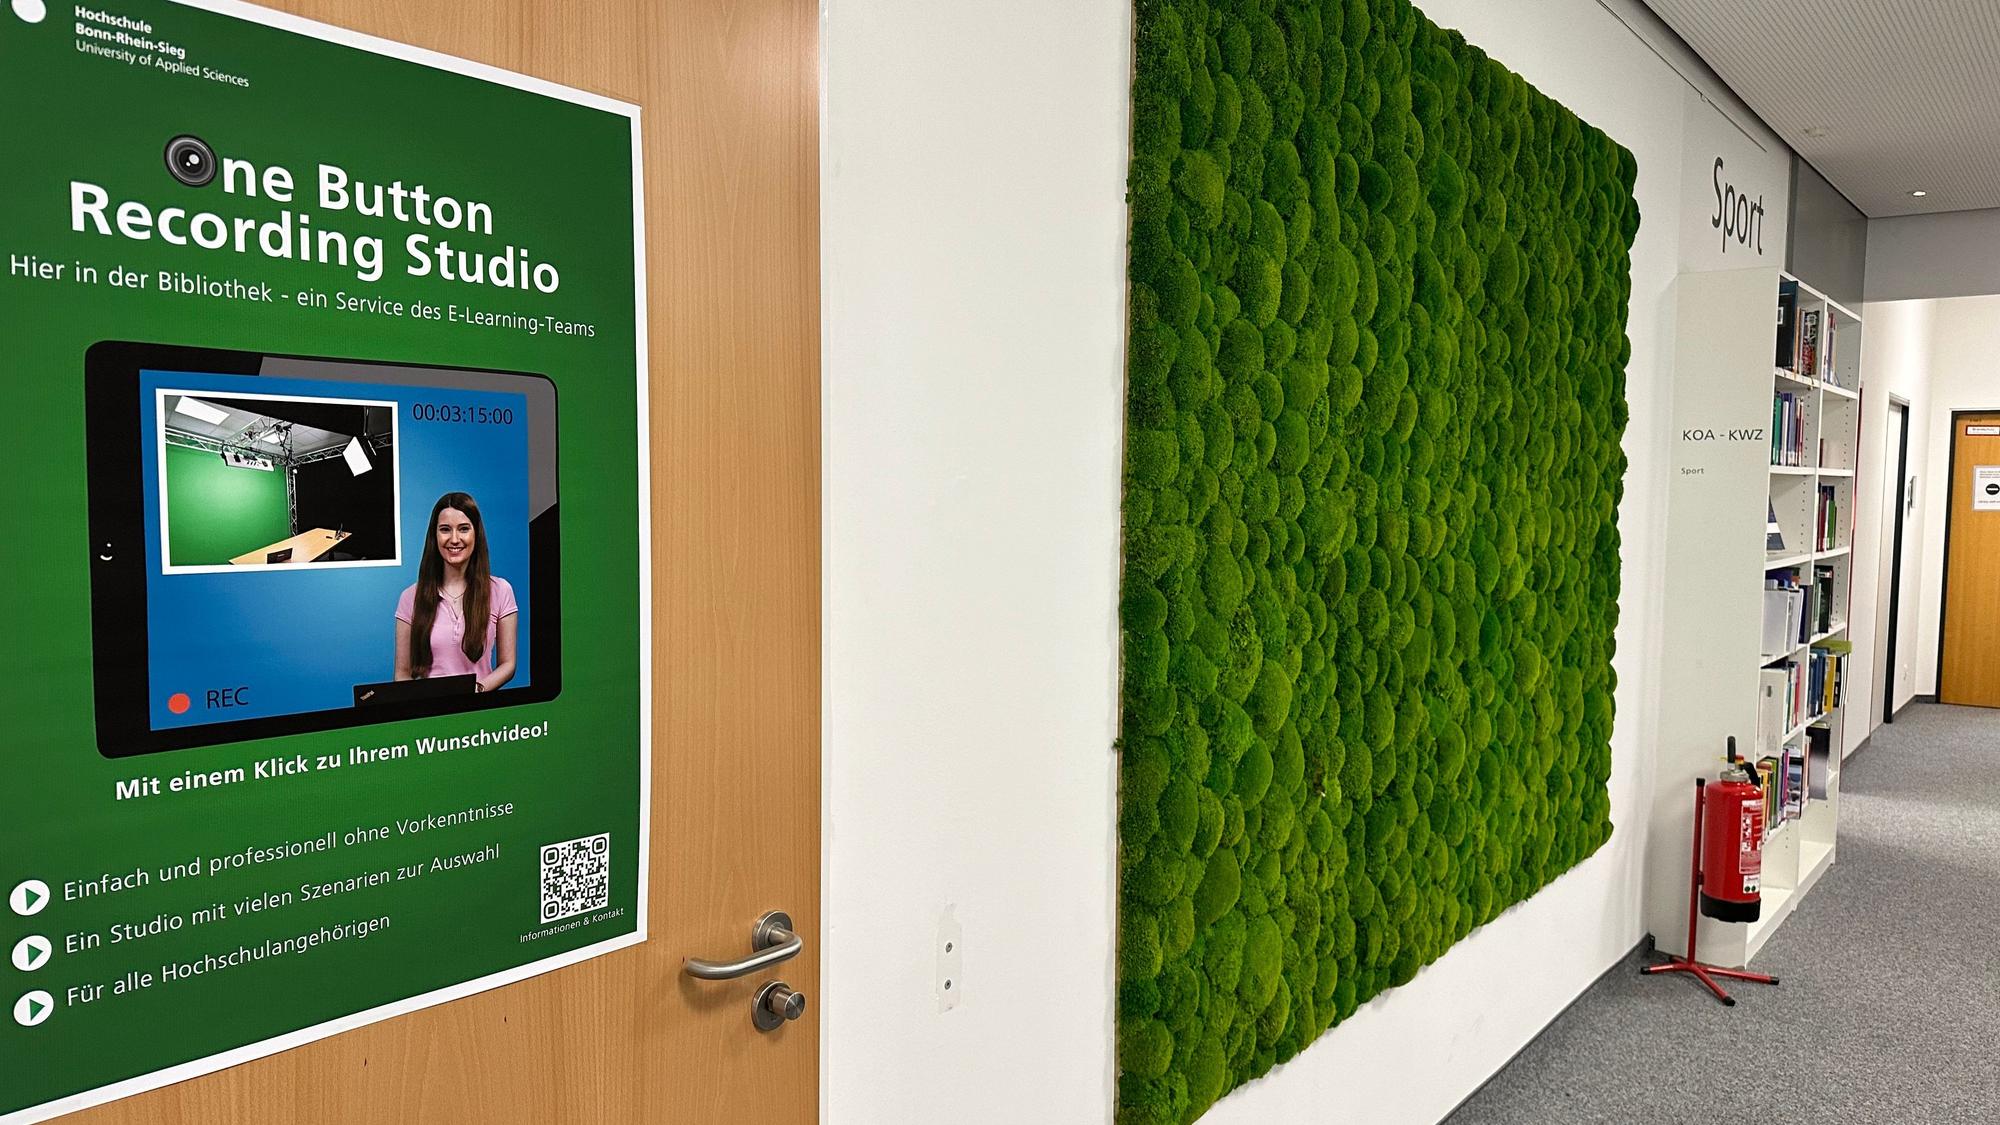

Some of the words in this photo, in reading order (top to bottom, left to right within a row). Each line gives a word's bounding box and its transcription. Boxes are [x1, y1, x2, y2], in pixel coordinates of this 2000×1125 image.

[75, 5, 152, 34] Hochschule
[75, 22, 186, 59] Bonn-Rhein-Sieg
[75, 39, 137, 65] University
[138, 54, 152, 66] of
[155, 57, 200, 77] Applied
[202, 67, 250, 88] Sciences
[318, 163, 494, 235] Button
[1711, 156, 1764, 256] Sport
[70, 180, 384, 282] Recording
[405, 233, 560, 294] Studio
[10, 253, 65, 280] Hier
[75, 260, 98, 284] in
[108, 265, 149, 289] der
[158, 271, 273, 303] Bibliothek
[297, 287, 327, 308] ein
[335, 291, 404, 316] Service
[410, 299, 442, 321] des
[448, 304, 595, 338] E-Learning-Teams
[412, 403, 513, 425] 00:03:15:00
[1682, 429, 1715, 441] KOA
[1728, 428, 1763, 441] KWZ
[1681, 467, 1704, 476] Sport
[206, 686, 249, 709] REC
[116, 777, 161, 801] Mit
[169, 768, 245, 792] einem
[254, 754, 309, 780] Klick
[316, 754, 341, 770] zu
[349, 744, 409, 766] Ihrem
[415, 720, 549, 755] Wunschvideo!
[64, 867, 149, 901] Einfach
[159, 856, 201, 882] und
[209, 832, 336, 877] professionell
[344, 826, 390, 846] ohne
[396, 802, 514, 835] Vorkenntnisse
[66, 933, 100, 954] Ein
[110, 913, 183, 944] Studio
[192, 903, 226, 926] mit
[233, 891, 292, 916] vielen
[300, 871, 390, 902] Szenarien
[397, 863, 424, 881] zur
[430, 843, 500, 873] Auswahl
[520, 920, 581, 943] Informationen
[583, 916, 590, 926] &
[592, 907, 624, 923] Kontakt
[67, 984, 105, 1007] Für
[113, 971, 153, 995] alle
[162, 915, 390, 983] Hochschulangehörigen
